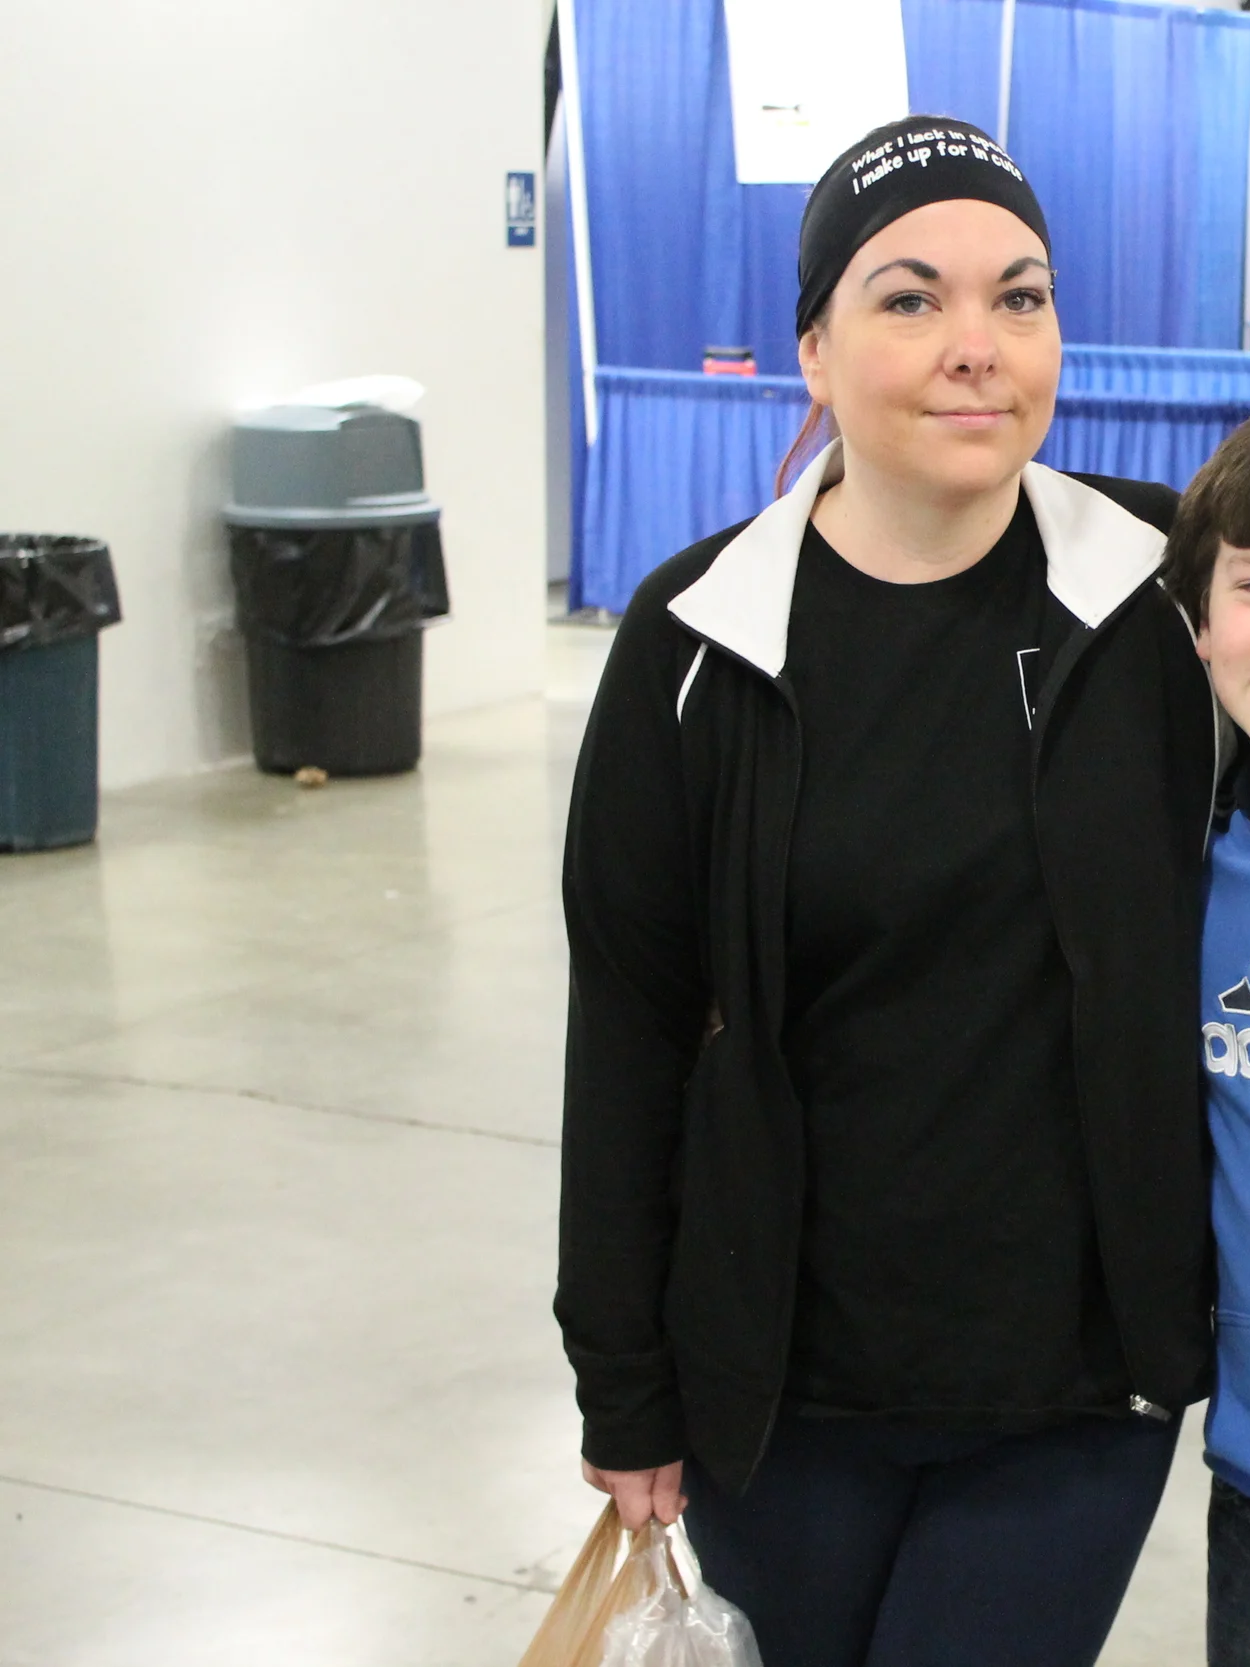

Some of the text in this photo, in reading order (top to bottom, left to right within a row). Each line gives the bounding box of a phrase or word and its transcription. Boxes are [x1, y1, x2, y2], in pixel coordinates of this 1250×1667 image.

[897, 135, 904, 148] I
[906, 128, 946, 145] lack
[948, 130, 966, 141] in
[852, 177, 860, 195] I
[861, 155, 904, 189] make
[906, 146, 931, 168] up
[936, 140, 968, 156] for
[970, 144, 989, 162] in
